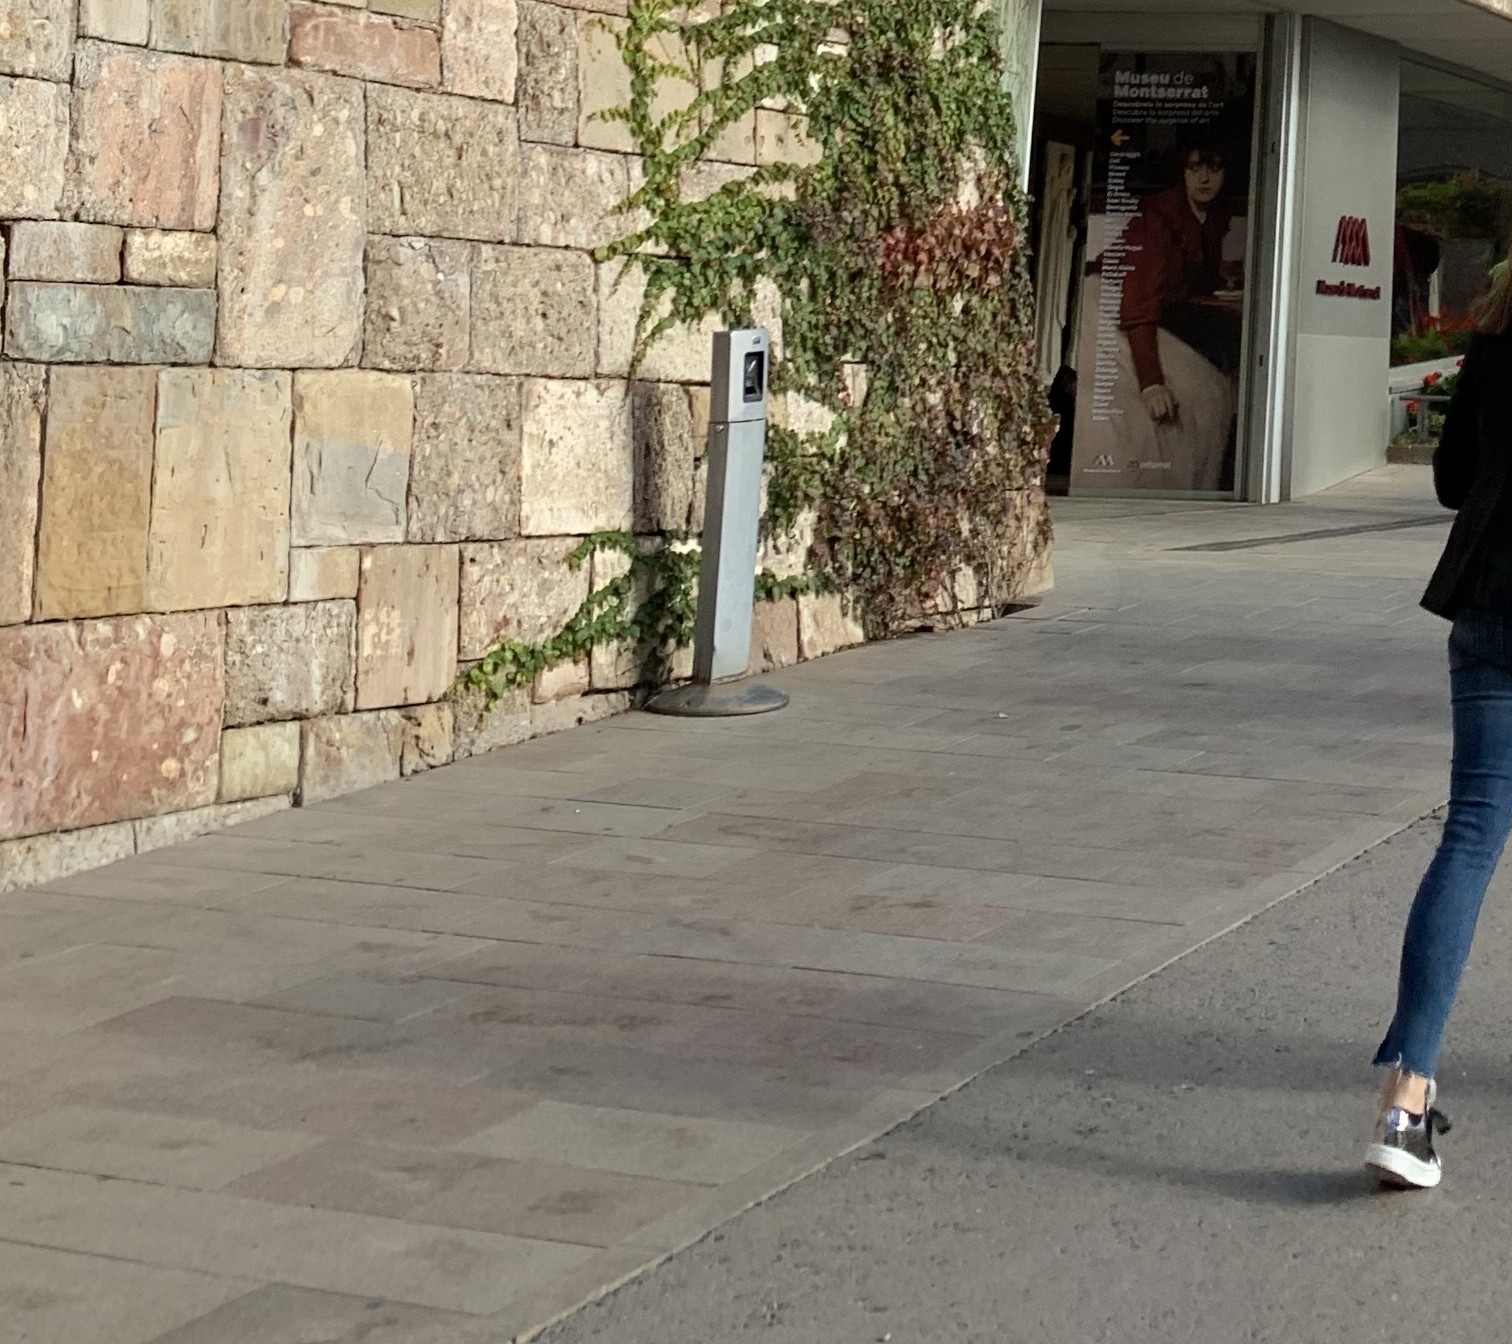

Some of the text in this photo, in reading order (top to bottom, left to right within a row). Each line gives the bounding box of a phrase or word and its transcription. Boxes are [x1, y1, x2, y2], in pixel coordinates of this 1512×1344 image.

[1115, 70, 1194, 84] Museu de
[1114, 84, 1209, 98] Montserrat
